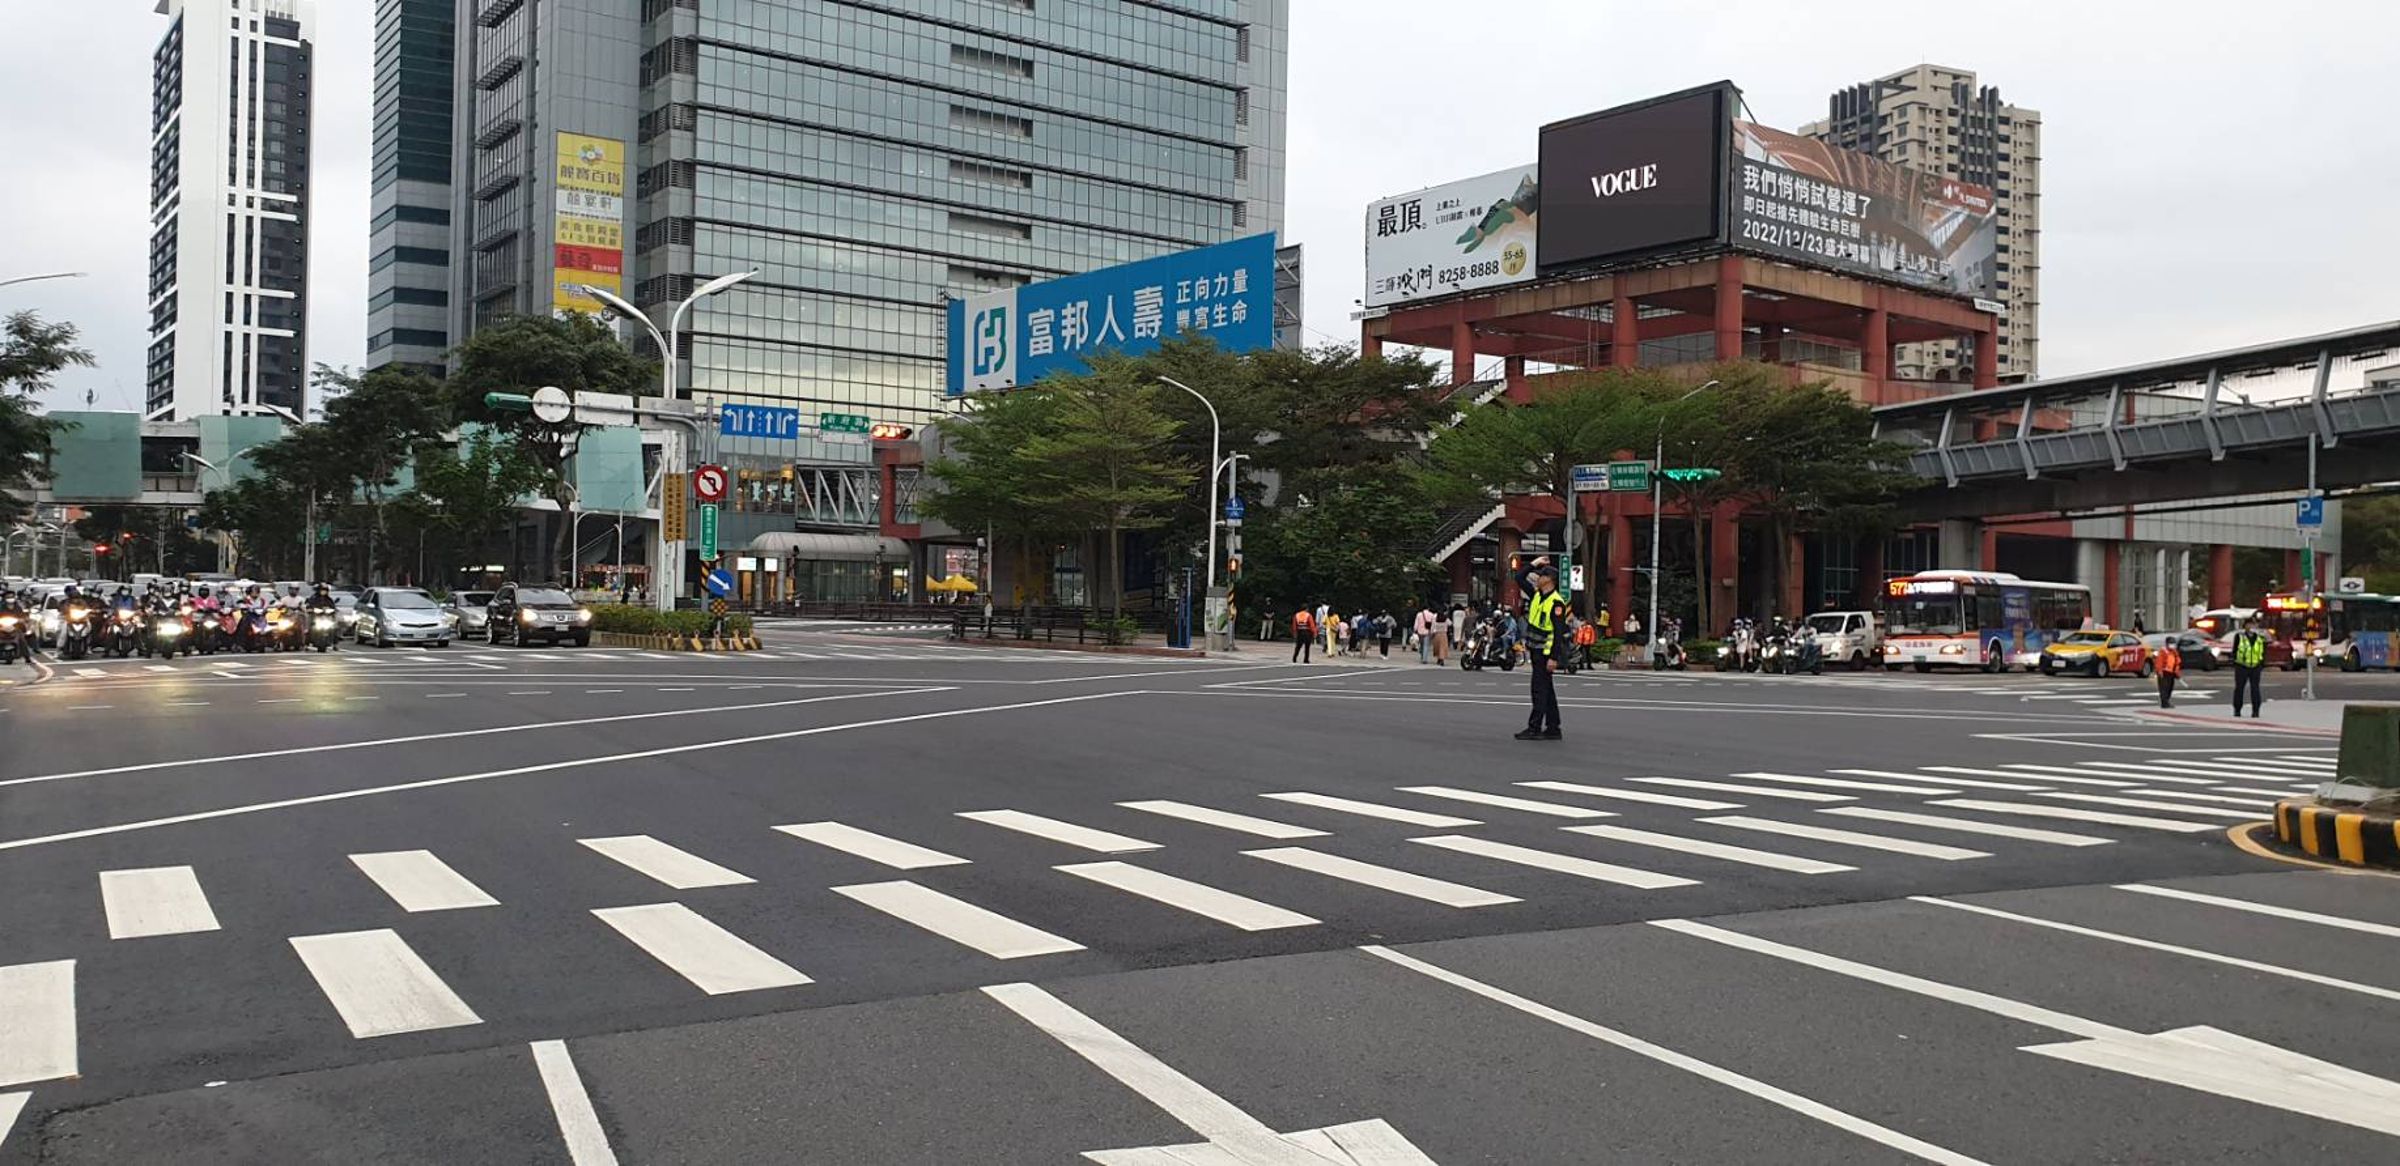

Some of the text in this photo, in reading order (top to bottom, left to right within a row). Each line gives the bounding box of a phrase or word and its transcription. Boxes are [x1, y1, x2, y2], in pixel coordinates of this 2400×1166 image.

[1591, 163, 1657, 198] VOGUE
[1743, 164, 1872, 219] 我們悄悄試營運了
[1176, 268, 1249, 304] 正向力量
[1438, 260, 1499, 284] 8258-8888
[1027, 285, 1164, 358] 富邦人壽
[1176, 299, 1249, 335] 豐富生命
